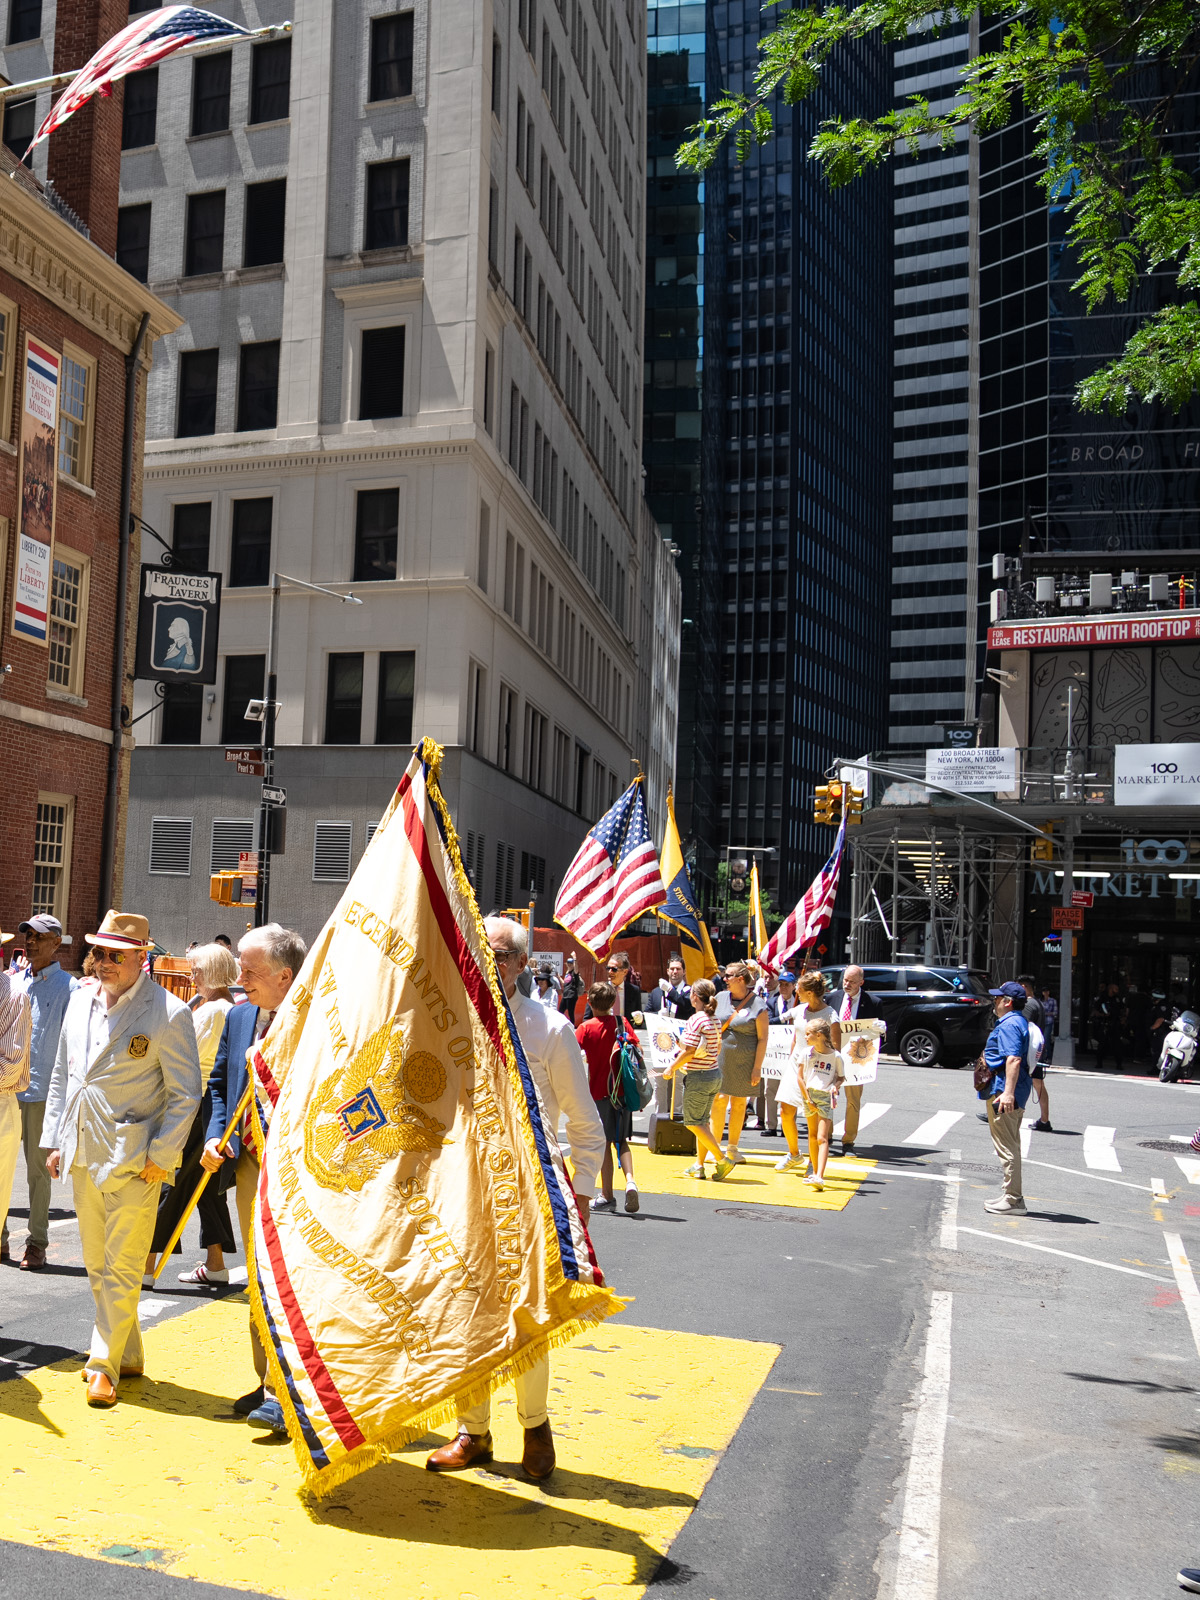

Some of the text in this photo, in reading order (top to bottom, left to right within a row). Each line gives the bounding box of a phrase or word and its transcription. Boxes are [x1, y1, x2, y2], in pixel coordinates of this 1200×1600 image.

[28, 371, 55, 398] FRAUNCES
[29, 397, 52, 421] MUSEUM
[1071, 444, 1144, 462] BROAD
[21, 538, 38, 555] LIBERTY
[20, 567, 45, 591] LIBERTY
[153, 572, 209, 588] FRAUNCES
[168, 585, 208, 600] TAVERN
[992, 630, 1003, 638] FOR
[1013, 625, 1092, 646] RESTAURANT
[1095, 623, 1128, 641] WITH
[1131, 619, 1190, 640] ROOFTOP
[992, 637, 1011, 647] LEASE
[947, 730, 972, 739] 100
[226, 751, 250, 761] Broad St
[237, 762, 255, 774] Pearl St
[1151, 763, 1178, 774] 100
[1117, 775, 1169, 784] MARKET
[1120, 838, 1188, 867] 100
[673, 886, 688, 906] STATE
[1055, 909, 1080, 918] RAISE
[1055, 918, 1080, 927] PLOW
[466, 1075, 505, 1140] THE
[488, 1148, 522, 1304] SIGNERS
[396, 1176, 481, 1299] SOCIETY
[298, 1216, 432, 1362] INDEPENDENCE
